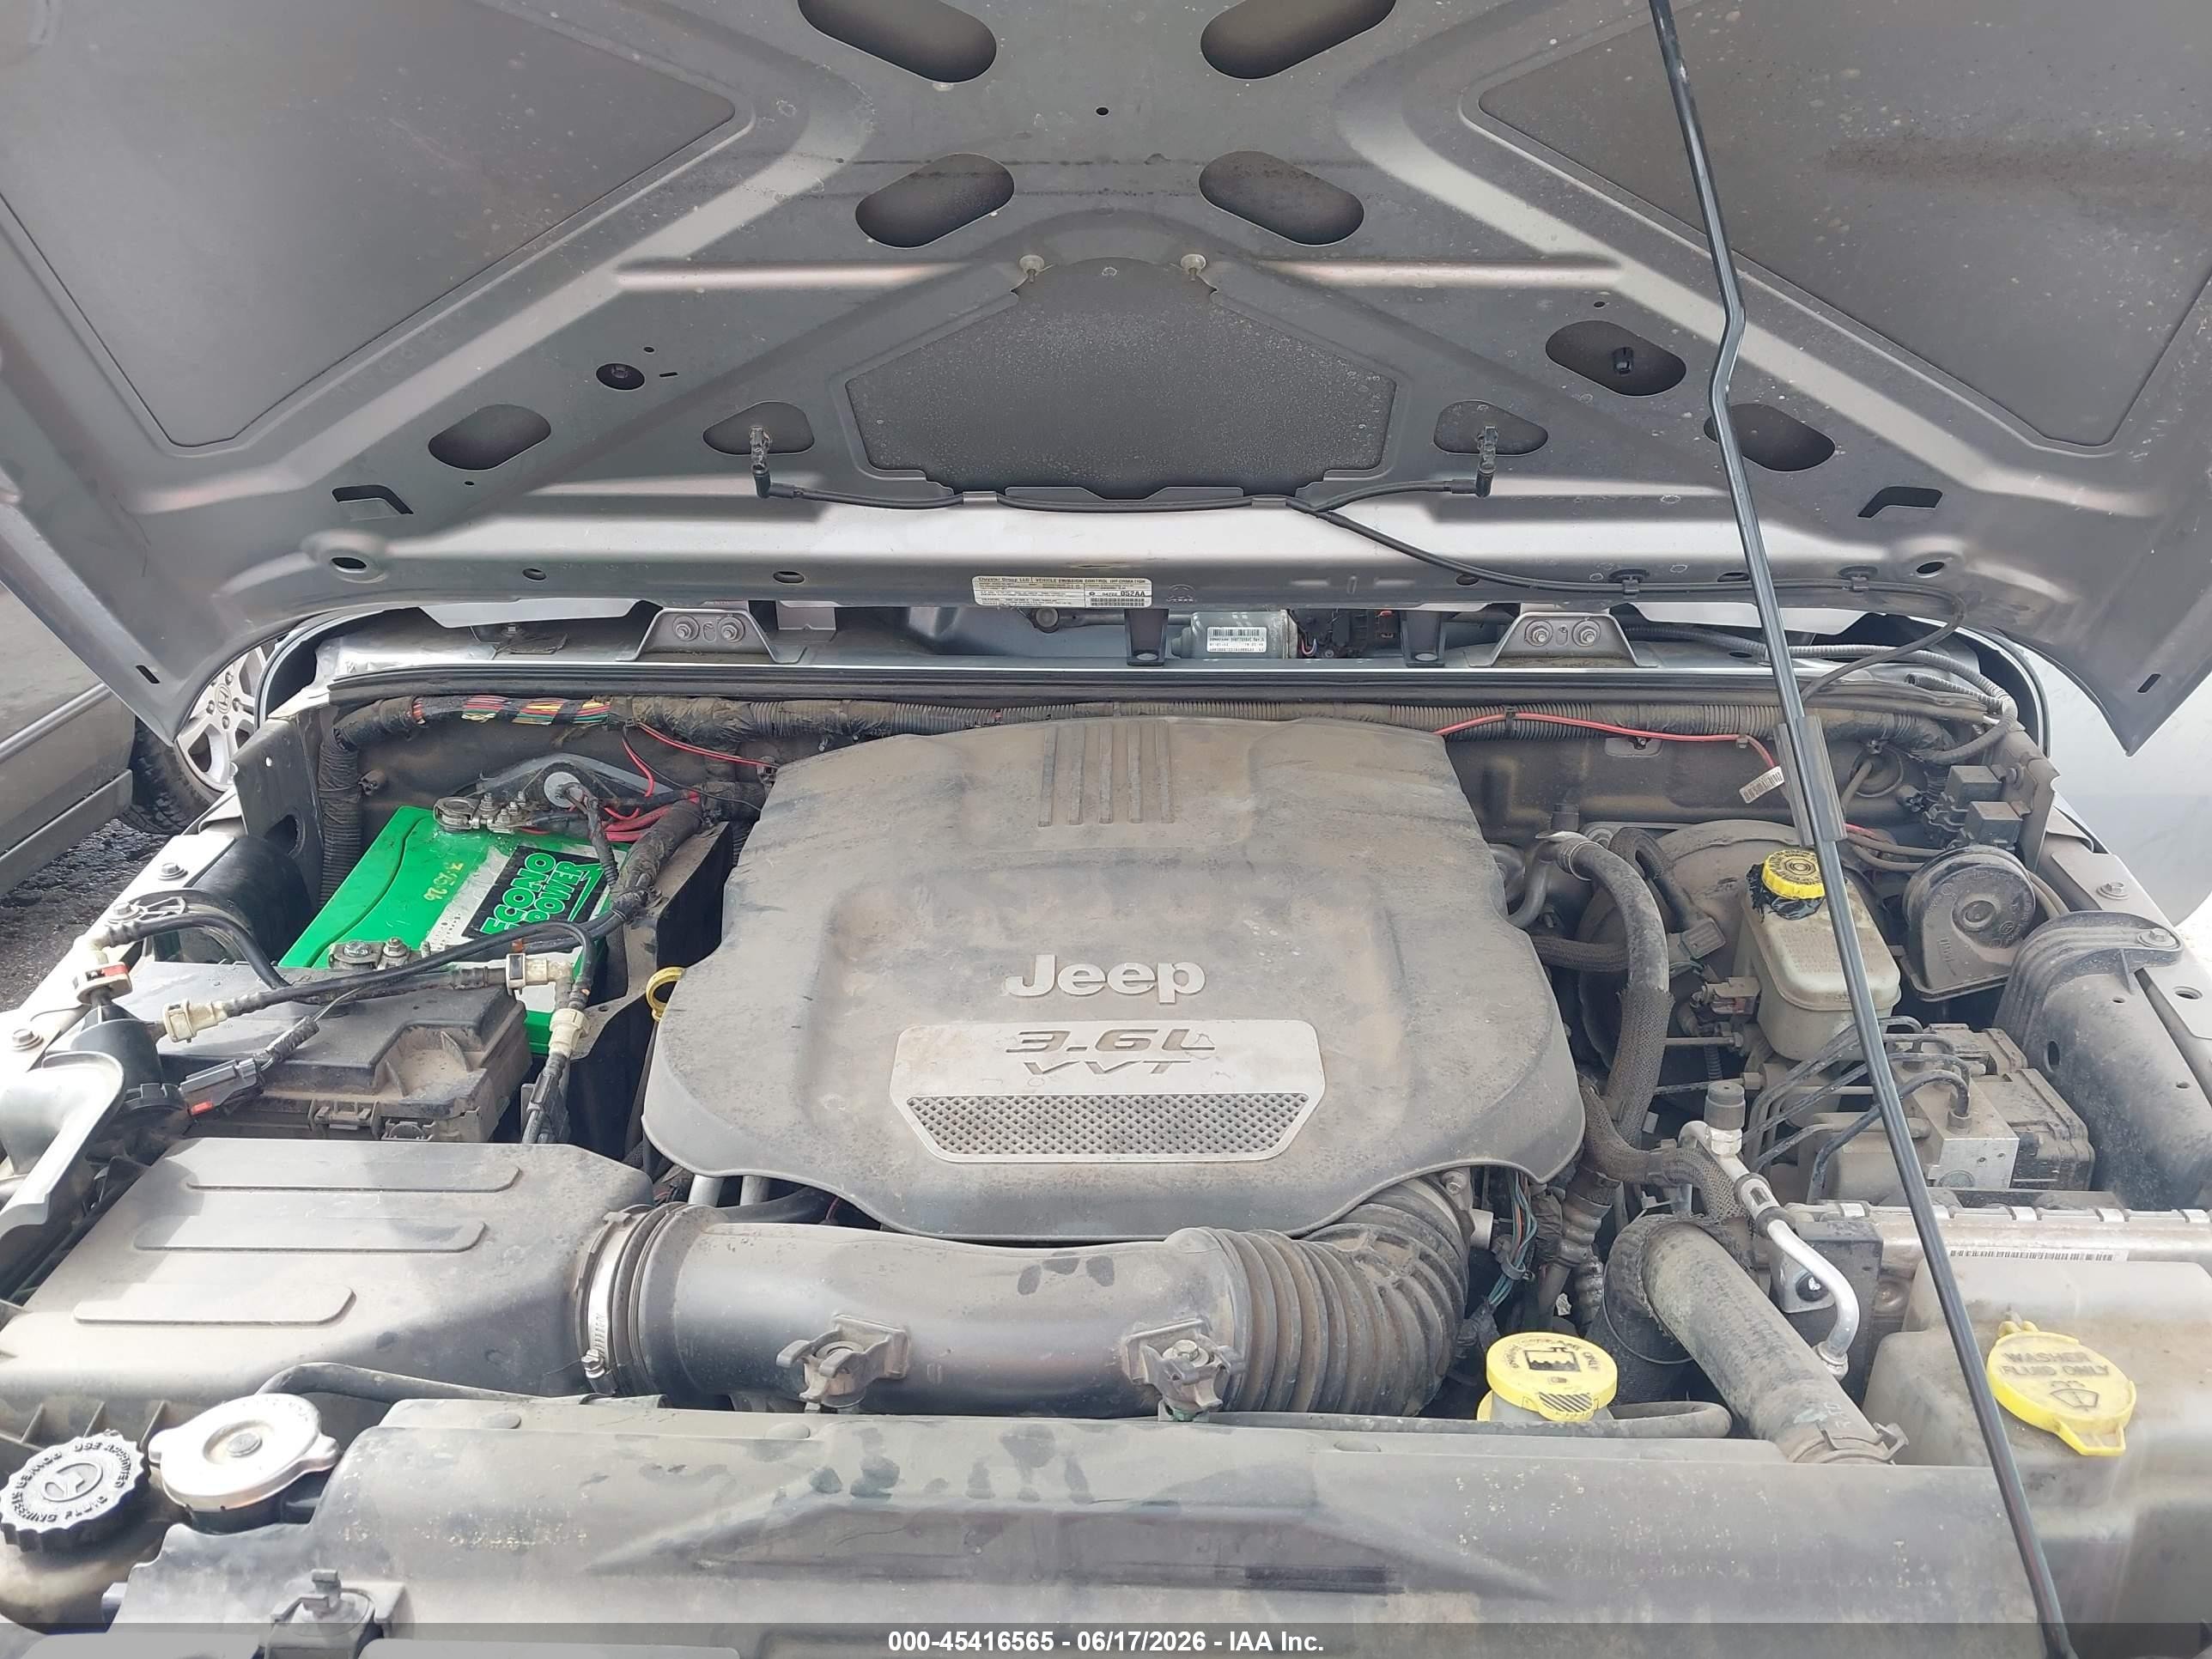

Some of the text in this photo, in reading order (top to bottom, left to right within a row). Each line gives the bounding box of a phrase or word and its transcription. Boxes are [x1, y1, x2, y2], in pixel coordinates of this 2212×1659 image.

[480, 853, 556, 935] ECONO
[525, 860, 587, 924] POWER
[1003, 954, 1206, 1005] Jeep
[1006, 1028, 1217, 1053] 3.6L
[1023, 1060, 1192, 1075] VVT
[2001, 1364, 2110, 1376] FLUID ONLY
[2002, 1352, 2093, 1364] WASHER
[73, 1442, 103, 1452] USE
[10, 1451, 108, 1523] POWER STEERING FLUID
